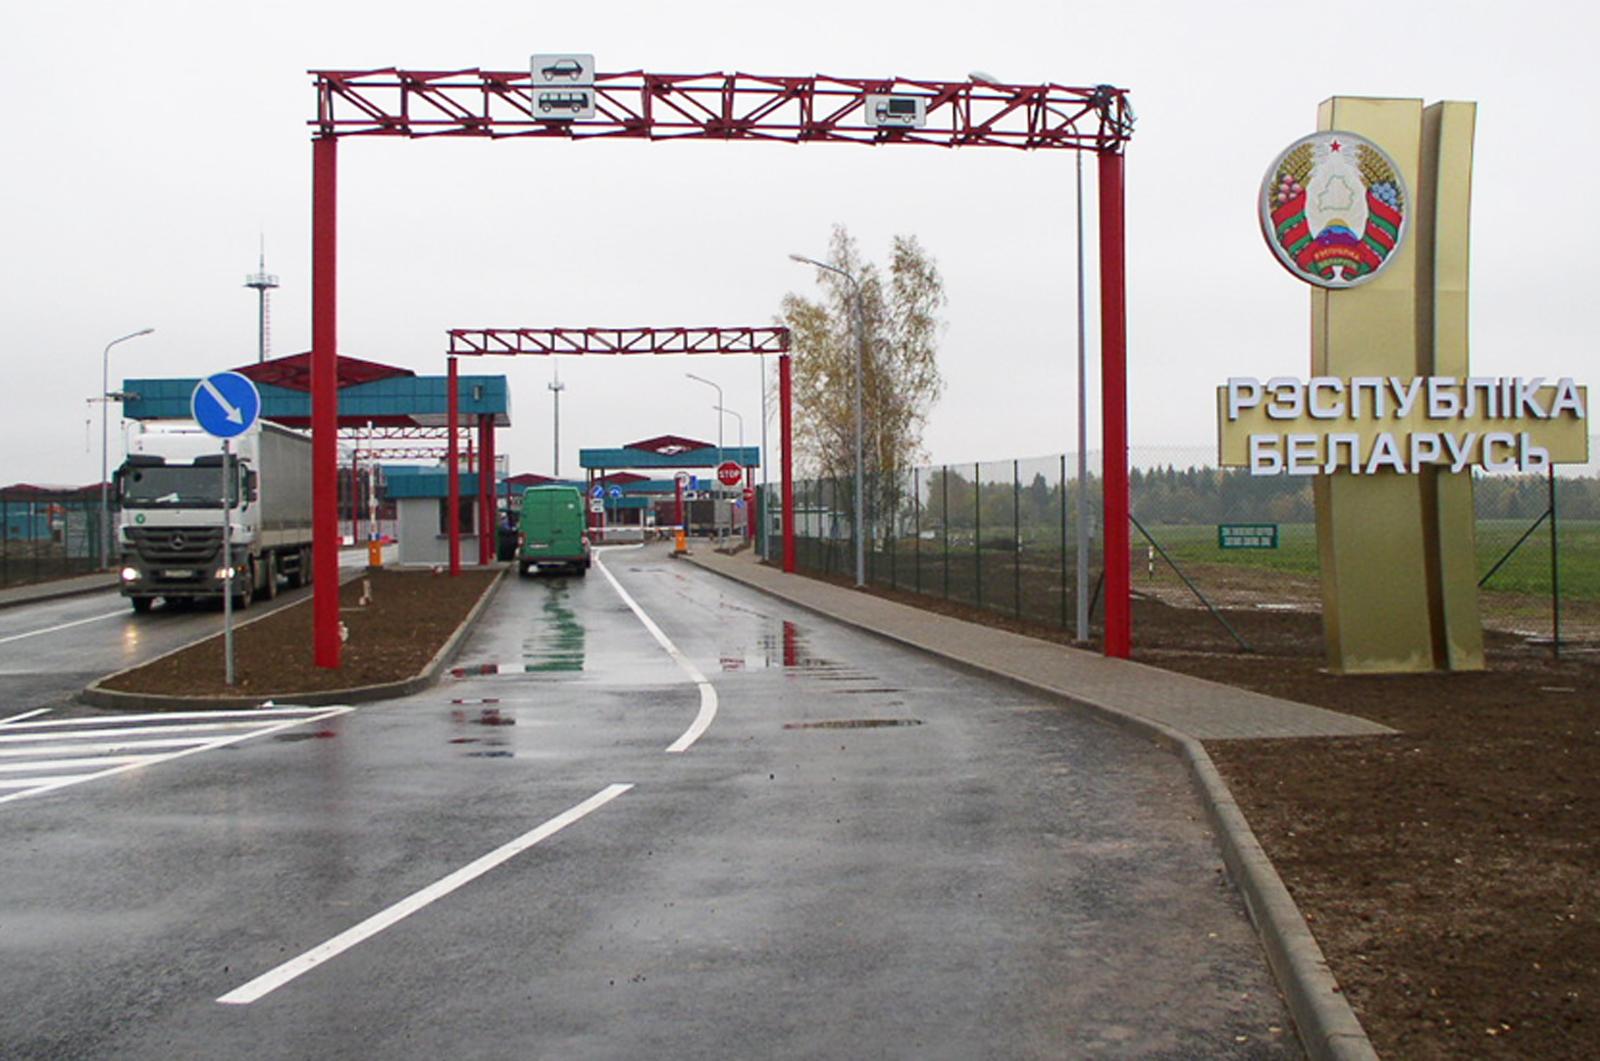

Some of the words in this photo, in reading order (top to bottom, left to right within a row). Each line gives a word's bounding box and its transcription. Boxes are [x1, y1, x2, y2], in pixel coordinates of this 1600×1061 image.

[1228, 377, 1585, 420] РЭСПУБЛІКА
[719, 469, 740, 478] STOP
[1250, 432, 1549, 476] БЕЛАРУСЬ
